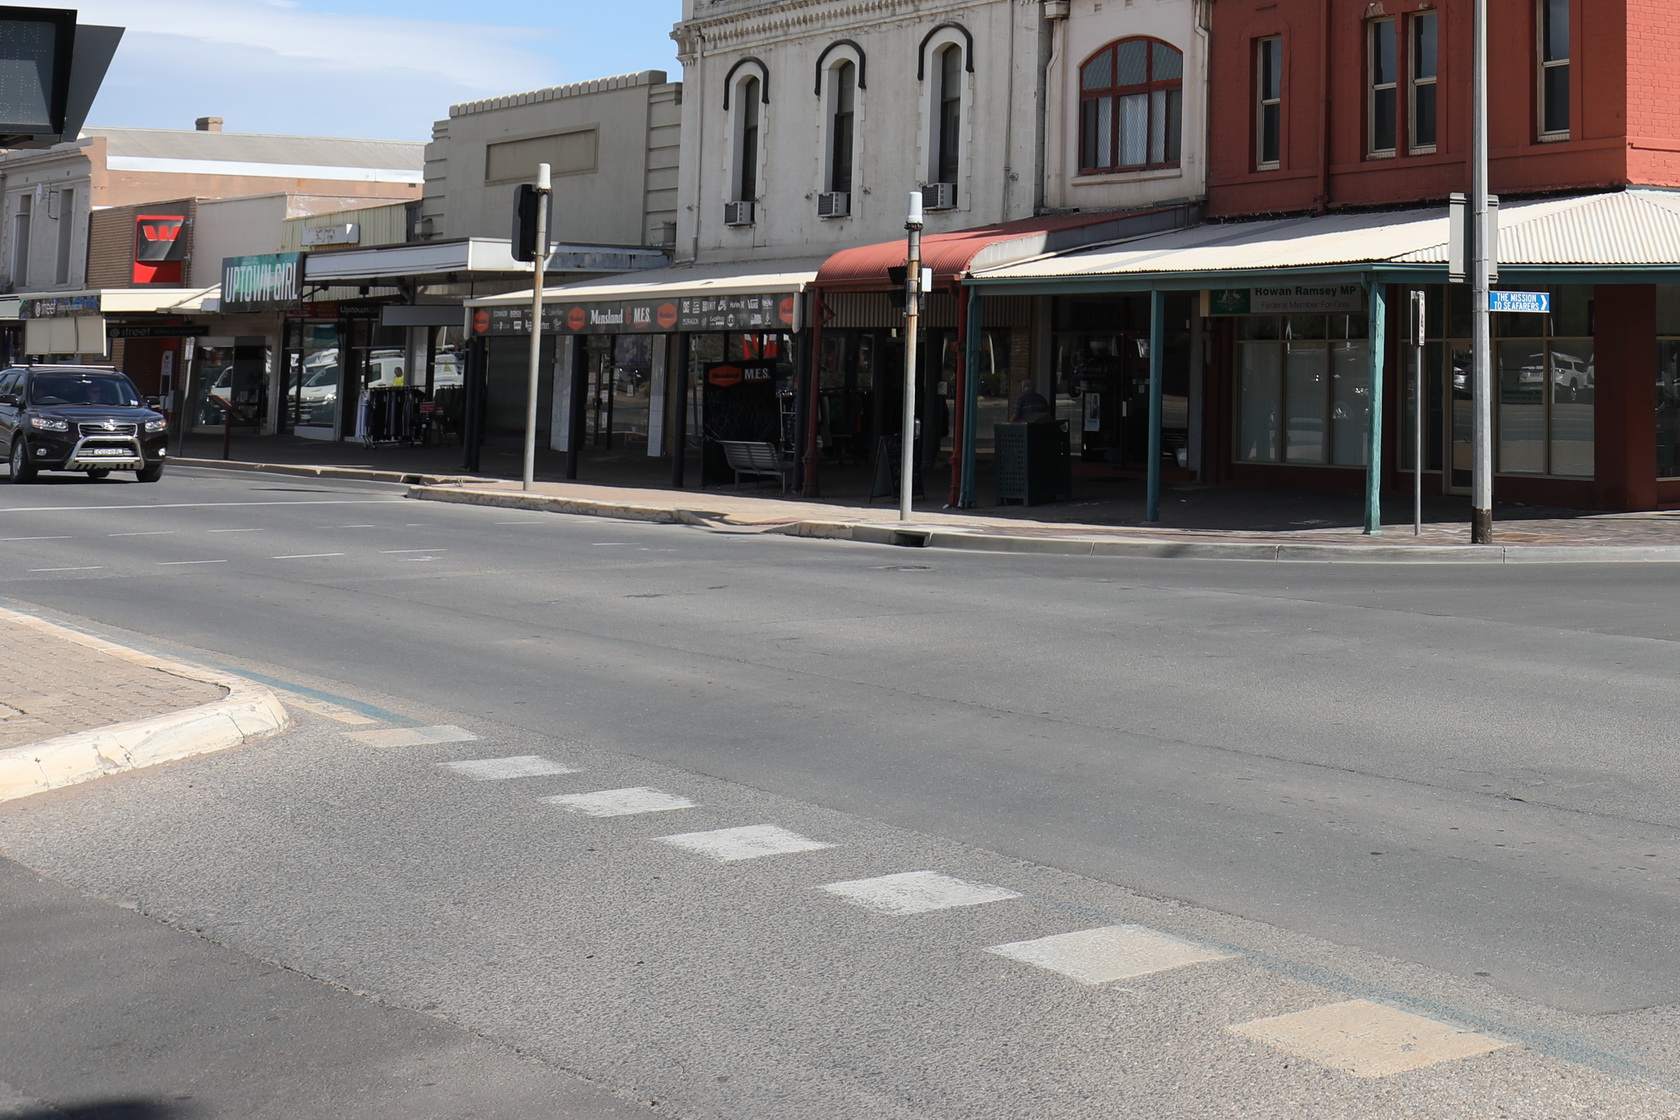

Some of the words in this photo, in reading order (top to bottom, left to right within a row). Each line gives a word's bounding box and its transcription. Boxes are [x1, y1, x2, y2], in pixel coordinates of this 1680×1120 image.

[225, 264, 271, 303] UPTOWN
[273, 261, 298, 301] GIRL
[1255, 287, 1292, 296] Rowan
[1295, 285, 1337, 297] Ramsey
[1340, 285, 1356, 295] MP
[1497, 293, 1509, 302] THE
[1510, 293, 1537, 303] MISSION
[1261, 301, 1288, 309] Federal
[1289, 301, 1319, 309] Member
[1493, 301, 1502, 310] TO
[1503, 301, 1540, 311] SEAFARERS
[590, 308, 624, 325] Mensland
